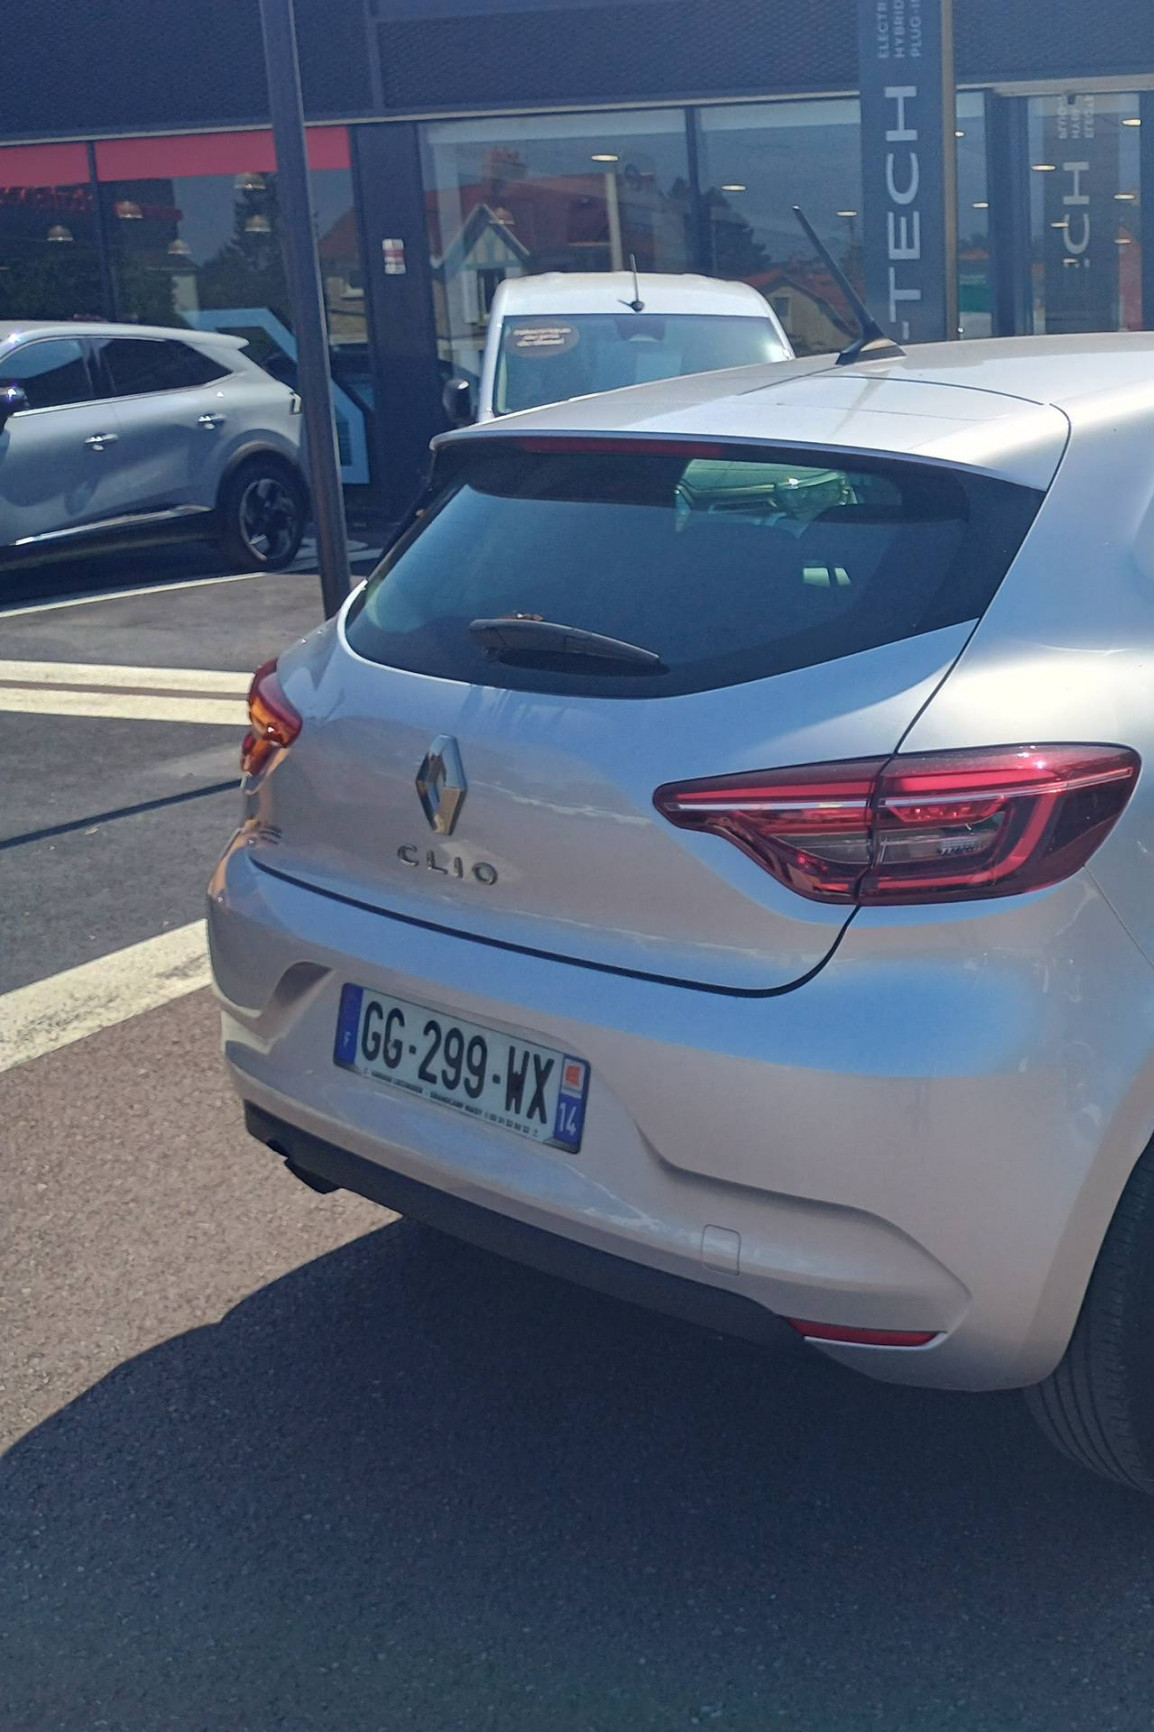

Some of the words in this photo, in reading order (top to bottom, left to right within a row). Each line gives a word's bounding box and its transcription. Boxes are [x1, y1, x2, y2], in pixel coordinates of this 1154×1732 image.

[910, 0, 923, 58] PLUG-I
[396, 843, 498, 886] CLIO
[361, 1000, 555, 1125] GG-299-WX
[558, 1100, 578, 1137] 14
